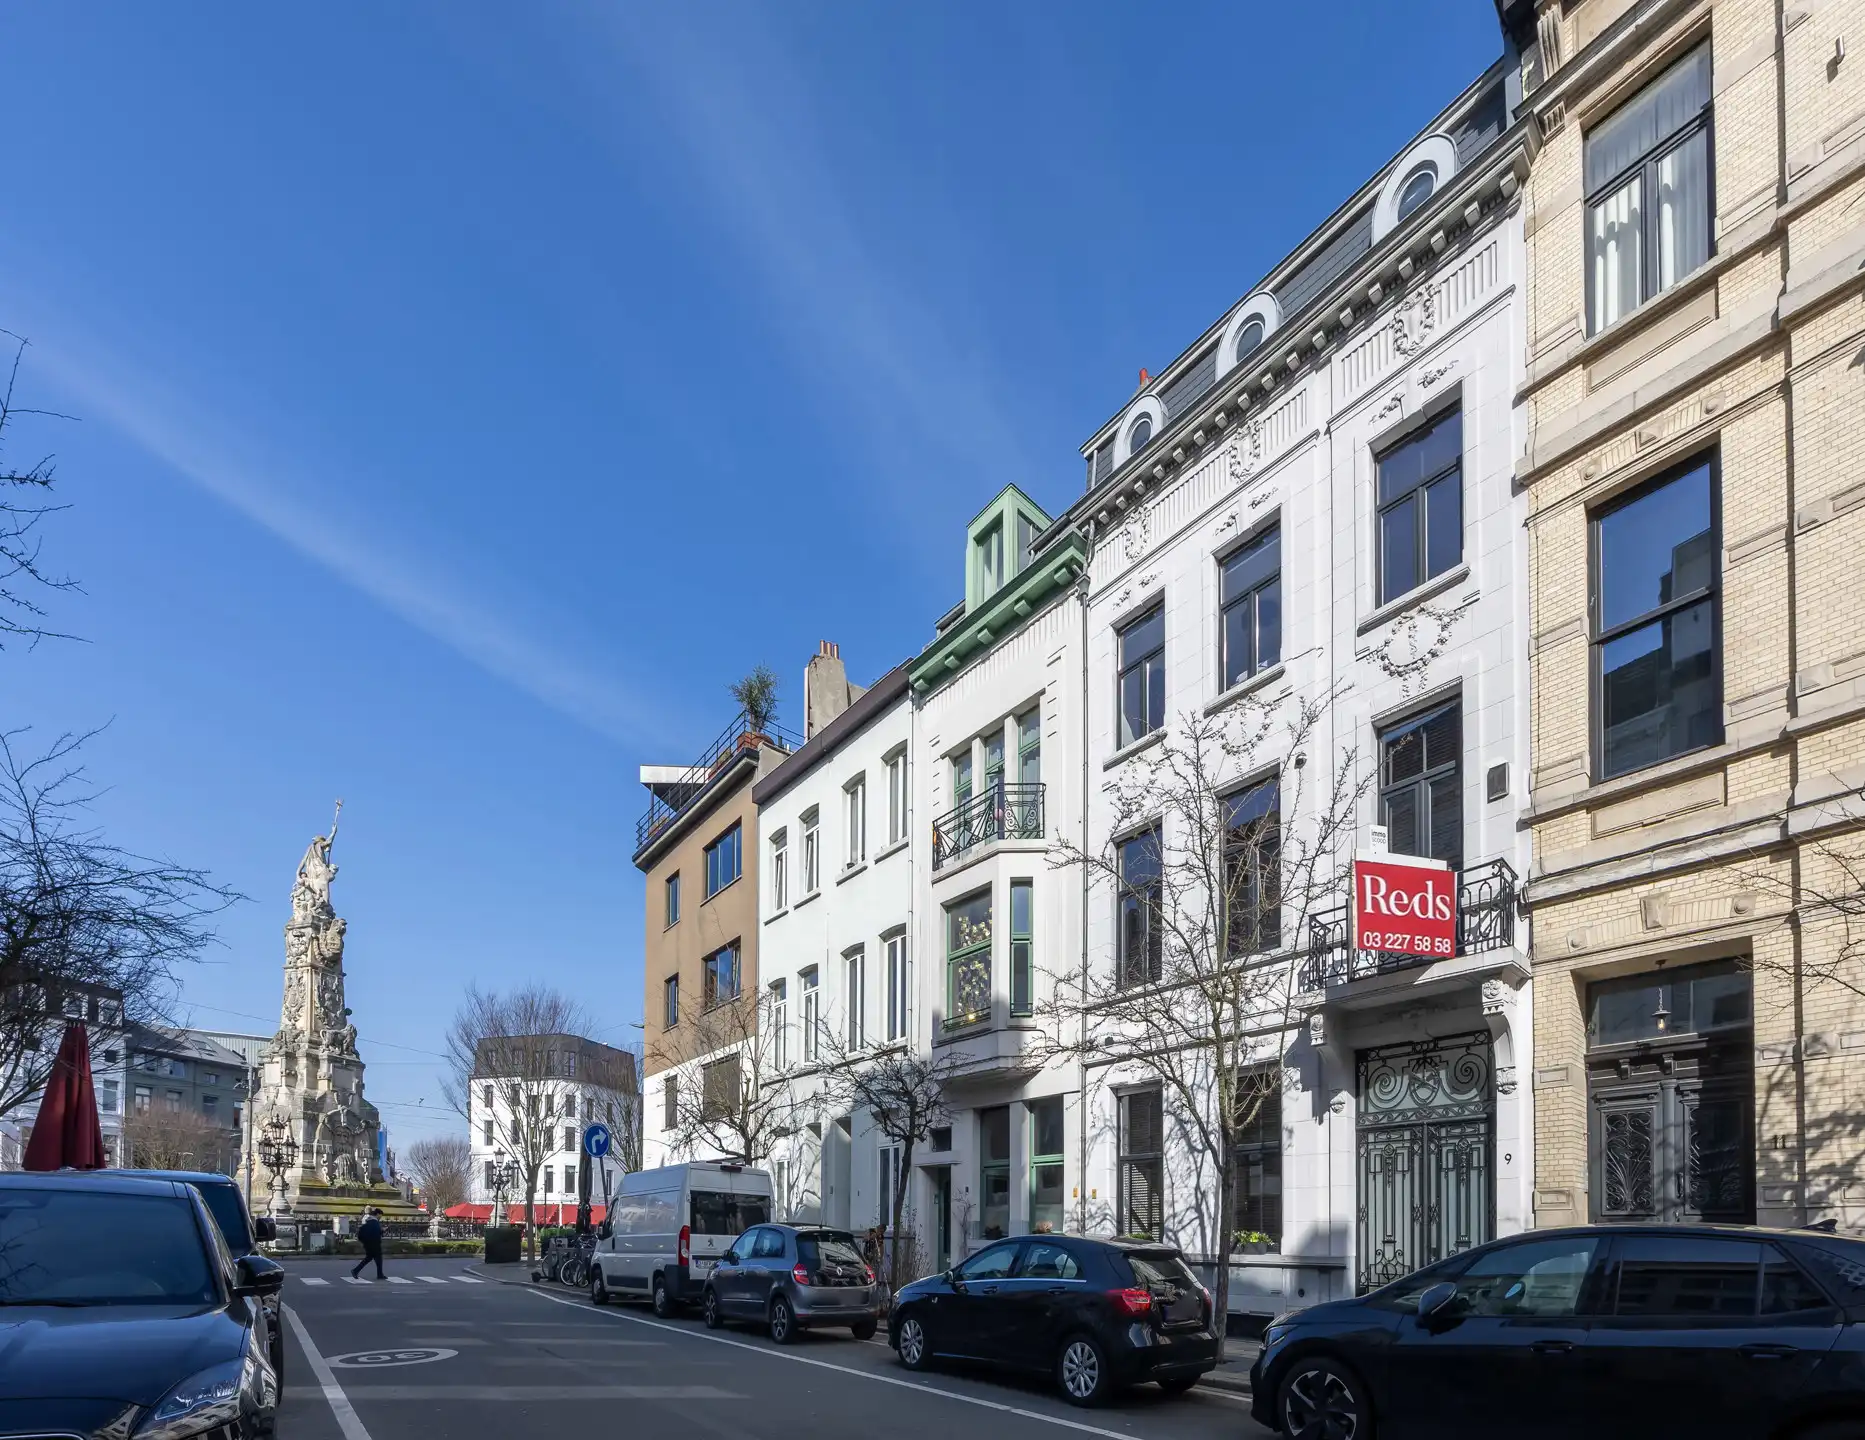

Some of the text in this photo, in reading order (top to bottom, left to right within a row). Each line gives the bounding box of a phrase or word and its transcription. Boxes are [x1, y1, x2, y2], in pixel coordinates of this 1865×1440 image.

[1362, 874, 1451, 921] Reds
[1363, 931, 1451, 954] 03 227 58 58
[1504, 1153, 1512, 1165] 9
